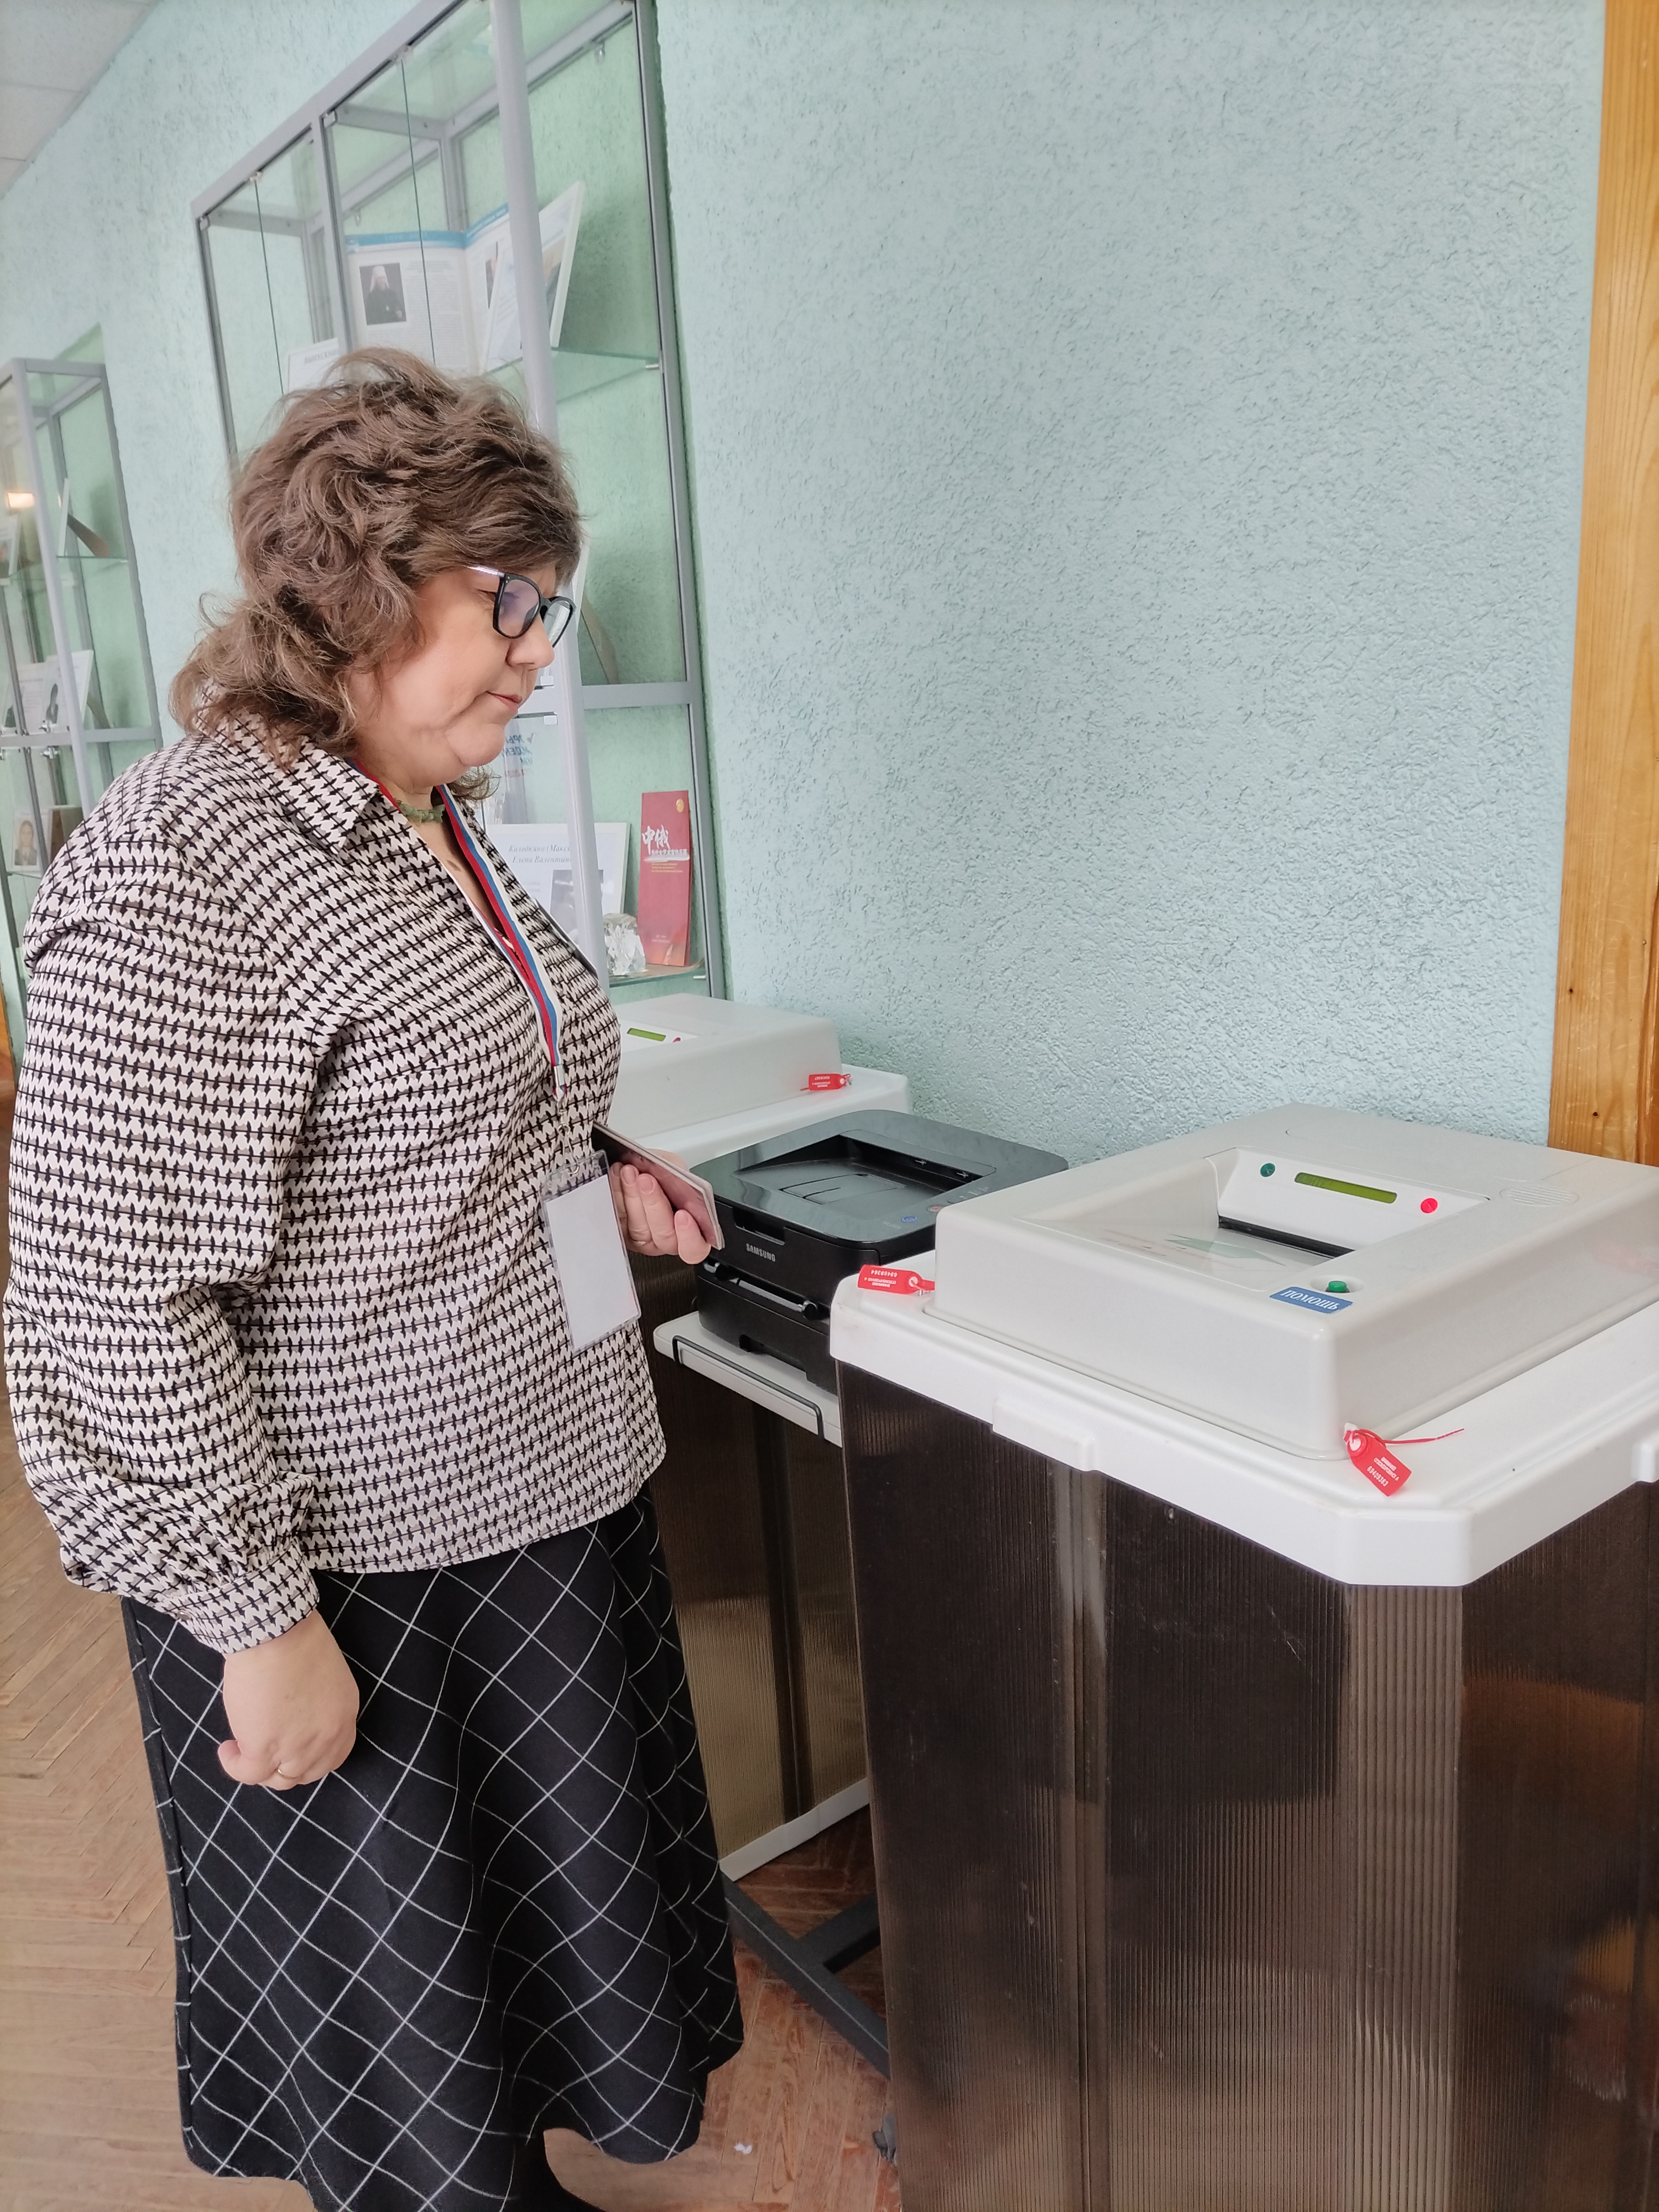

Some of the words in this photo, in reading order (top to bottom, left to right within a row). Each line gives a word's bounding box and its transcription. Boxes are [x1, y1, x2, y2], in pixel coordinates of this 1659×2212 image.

[746, 1243, 775, 1262] SAMSUNG
[1280, 1290, 1340, 1310] ПОМОЩЬ
[1366, 1465, 1389, 1487] 69409363
